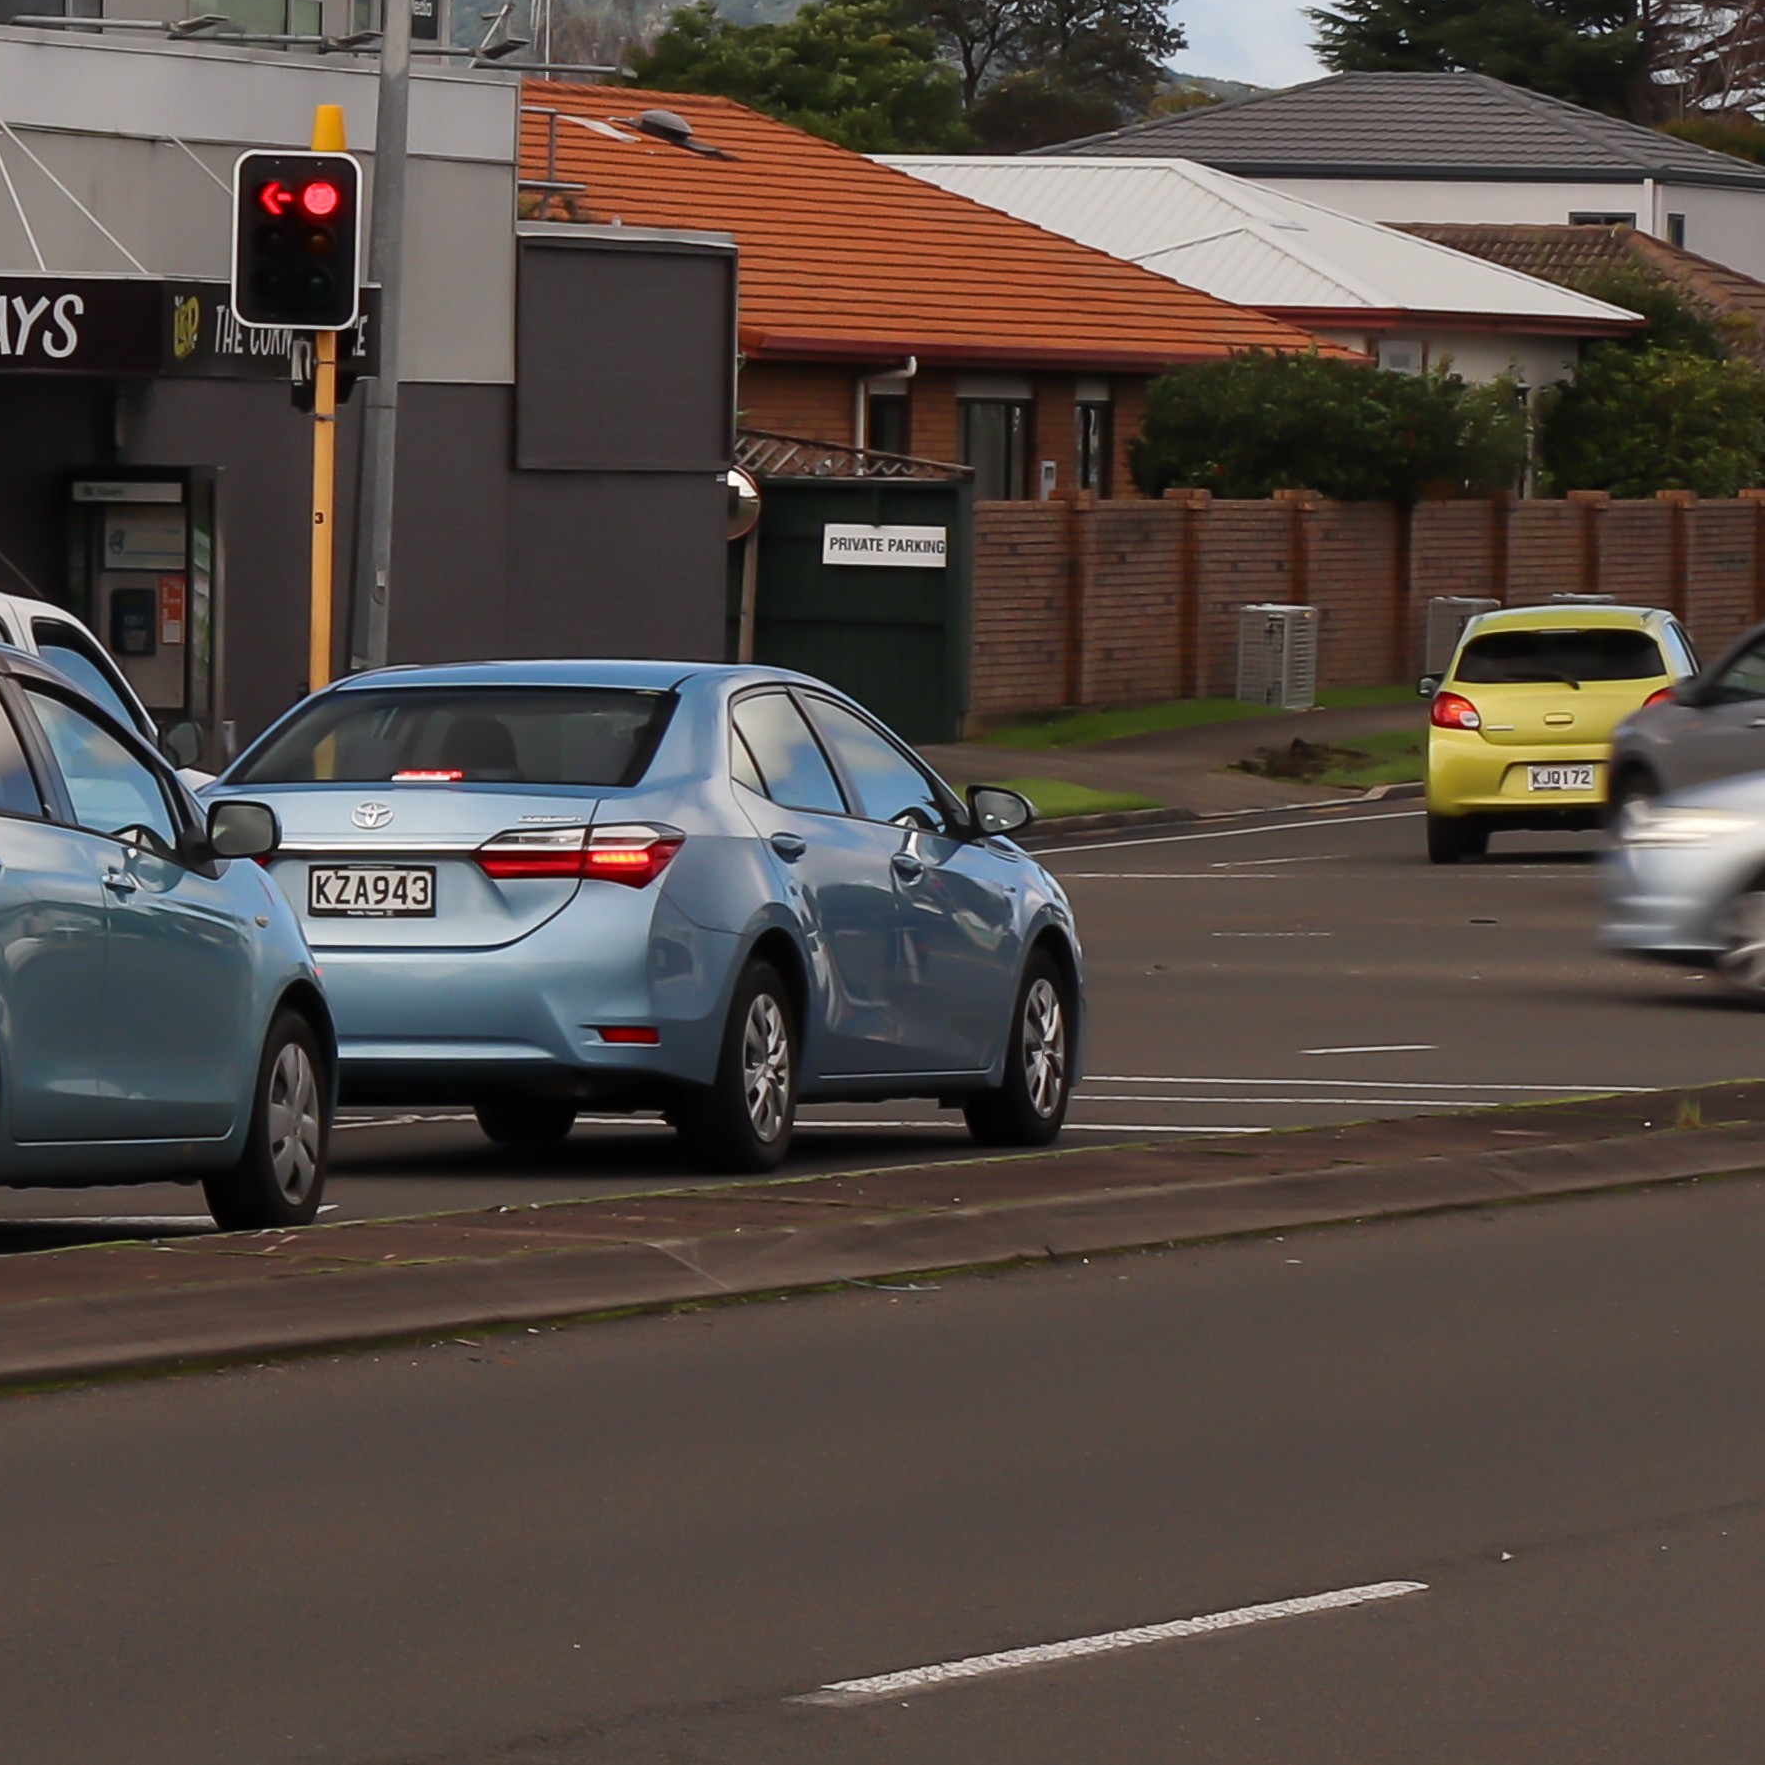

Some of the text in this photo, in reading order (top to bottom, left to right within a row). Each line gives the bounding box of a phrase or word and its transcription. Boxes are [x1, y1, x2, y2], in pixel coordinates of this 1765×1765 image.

[829, 536, 946, 554] PRIVATE PARKING
[315, 874, 429, 906] KZA943
